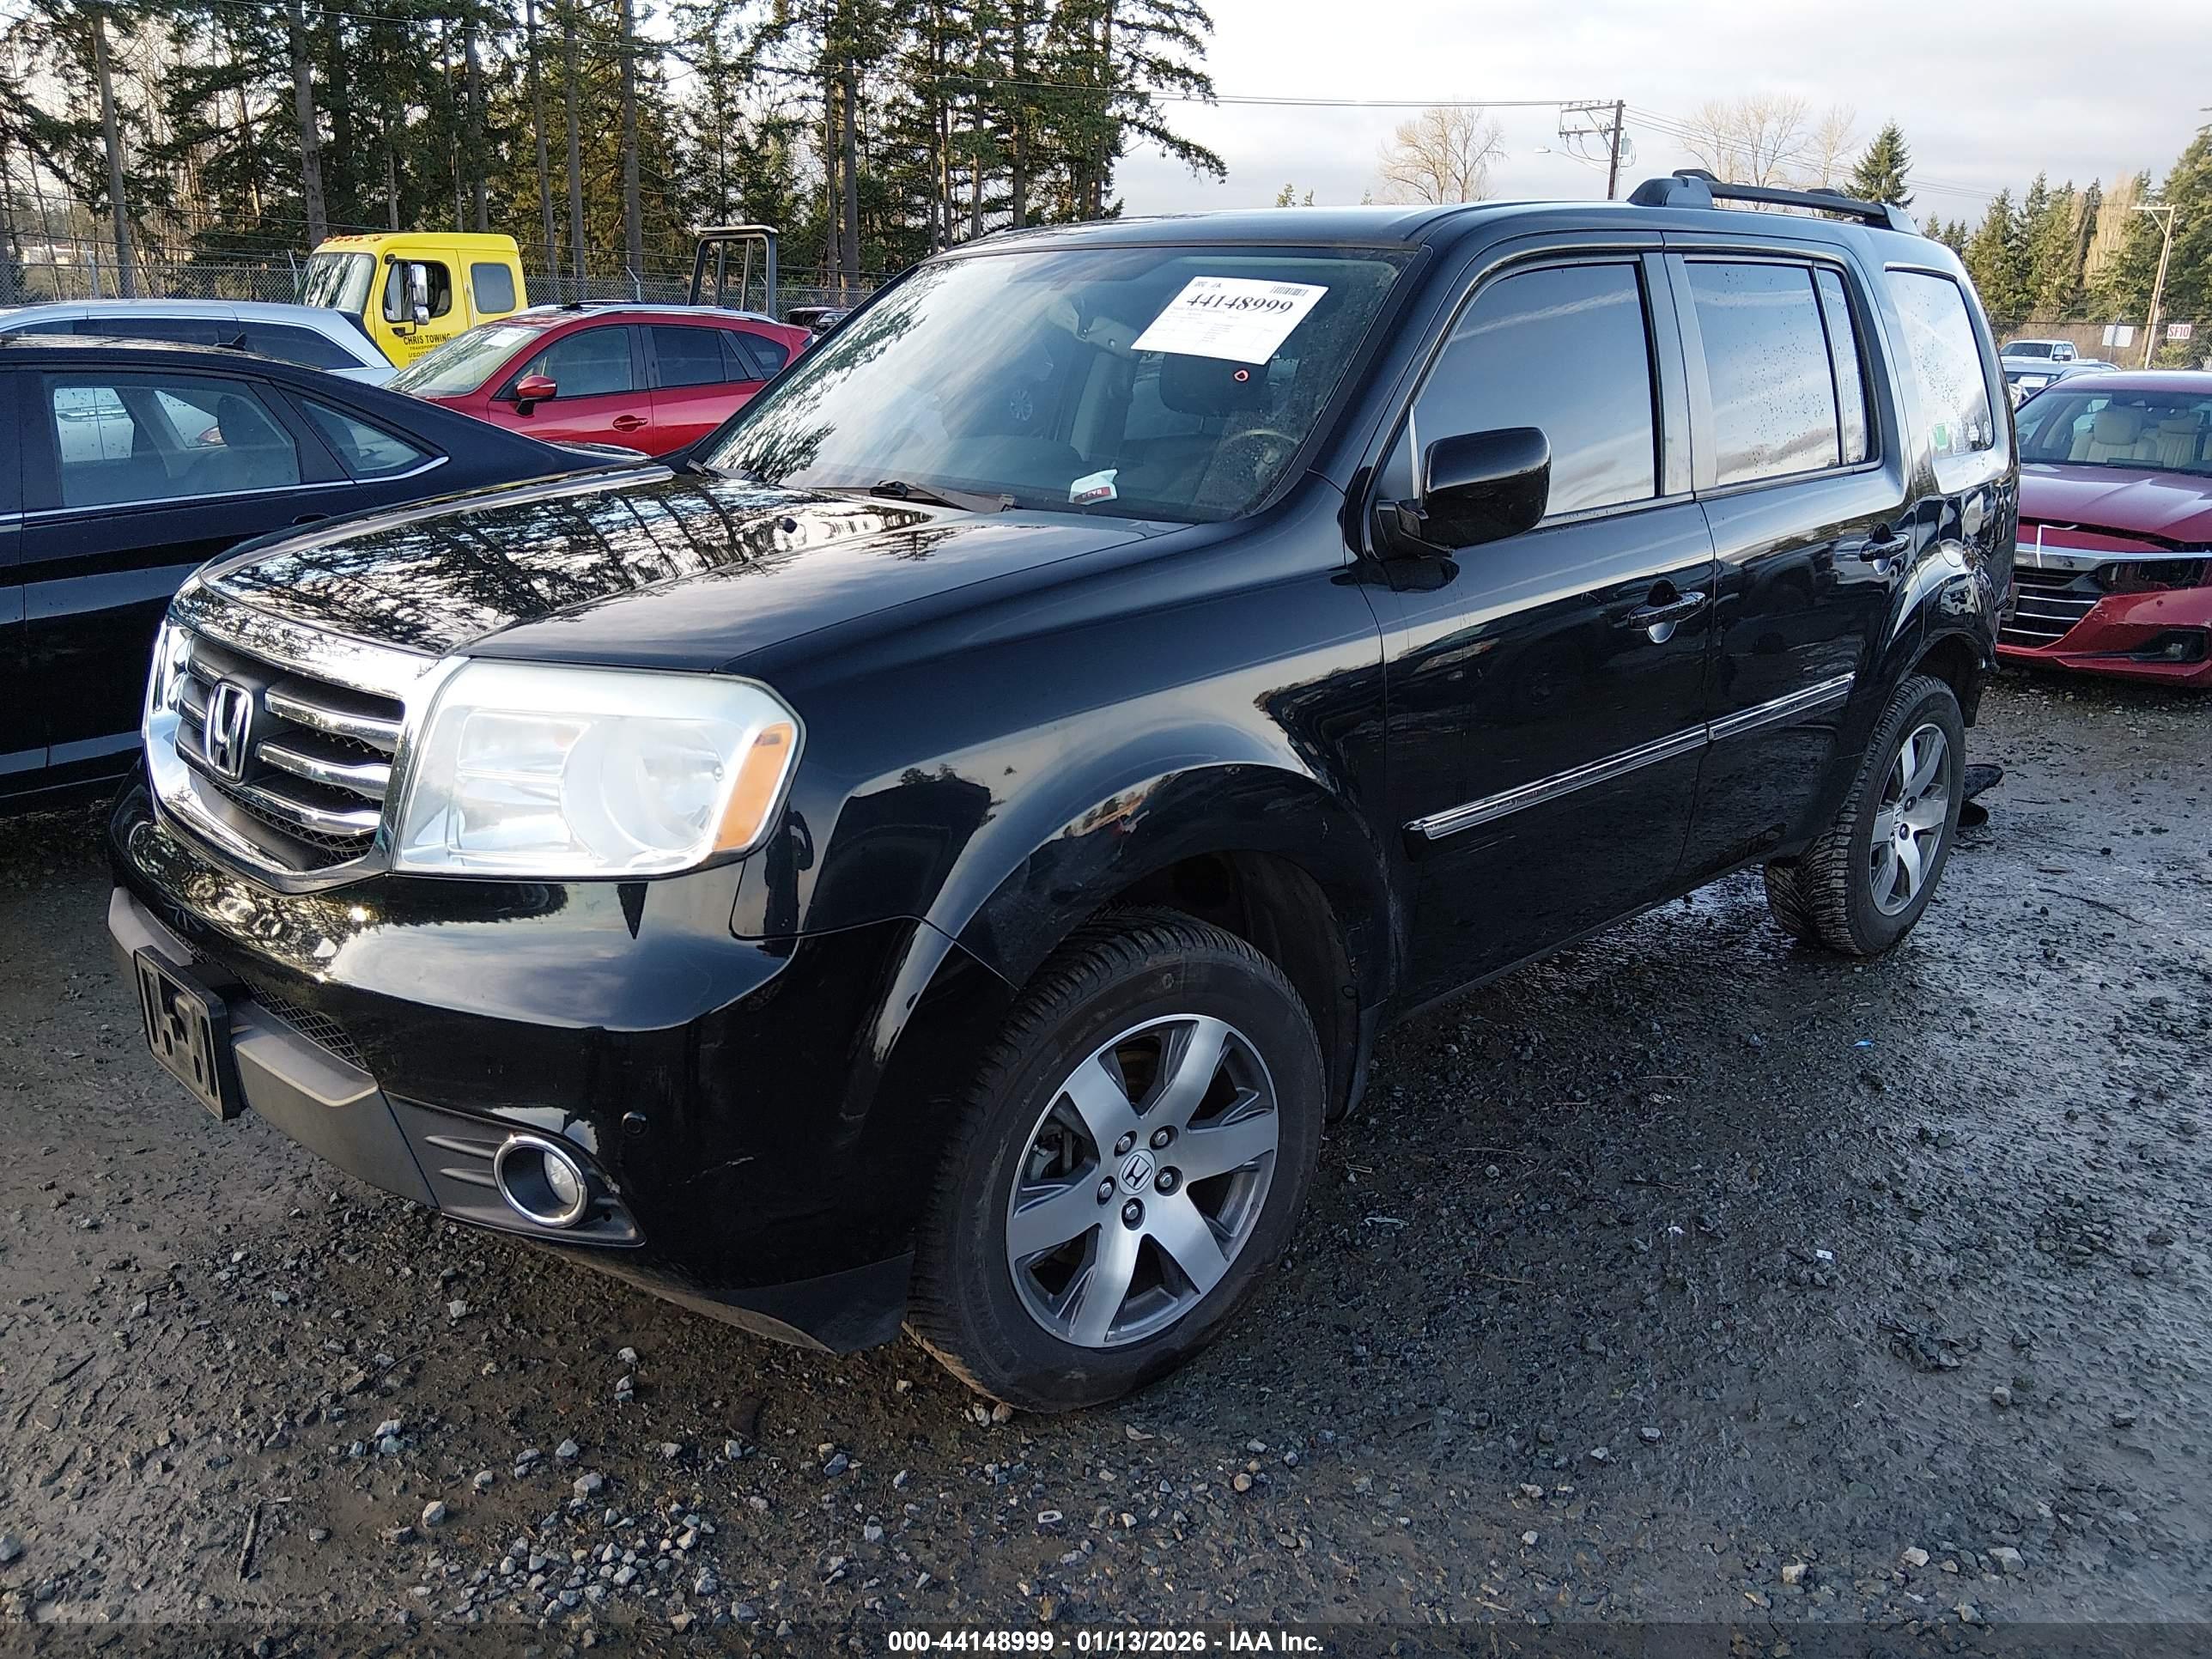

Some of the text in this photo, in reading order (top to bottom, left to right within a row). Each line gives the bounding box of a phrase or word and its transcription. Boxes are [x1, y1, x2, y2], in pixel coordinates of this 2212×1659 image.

[1187, 293, 1293, 314] 44148999
[2168, 325, 2190, 337] SF10
[403, 333, 452, 345] CHRIS TOWING
